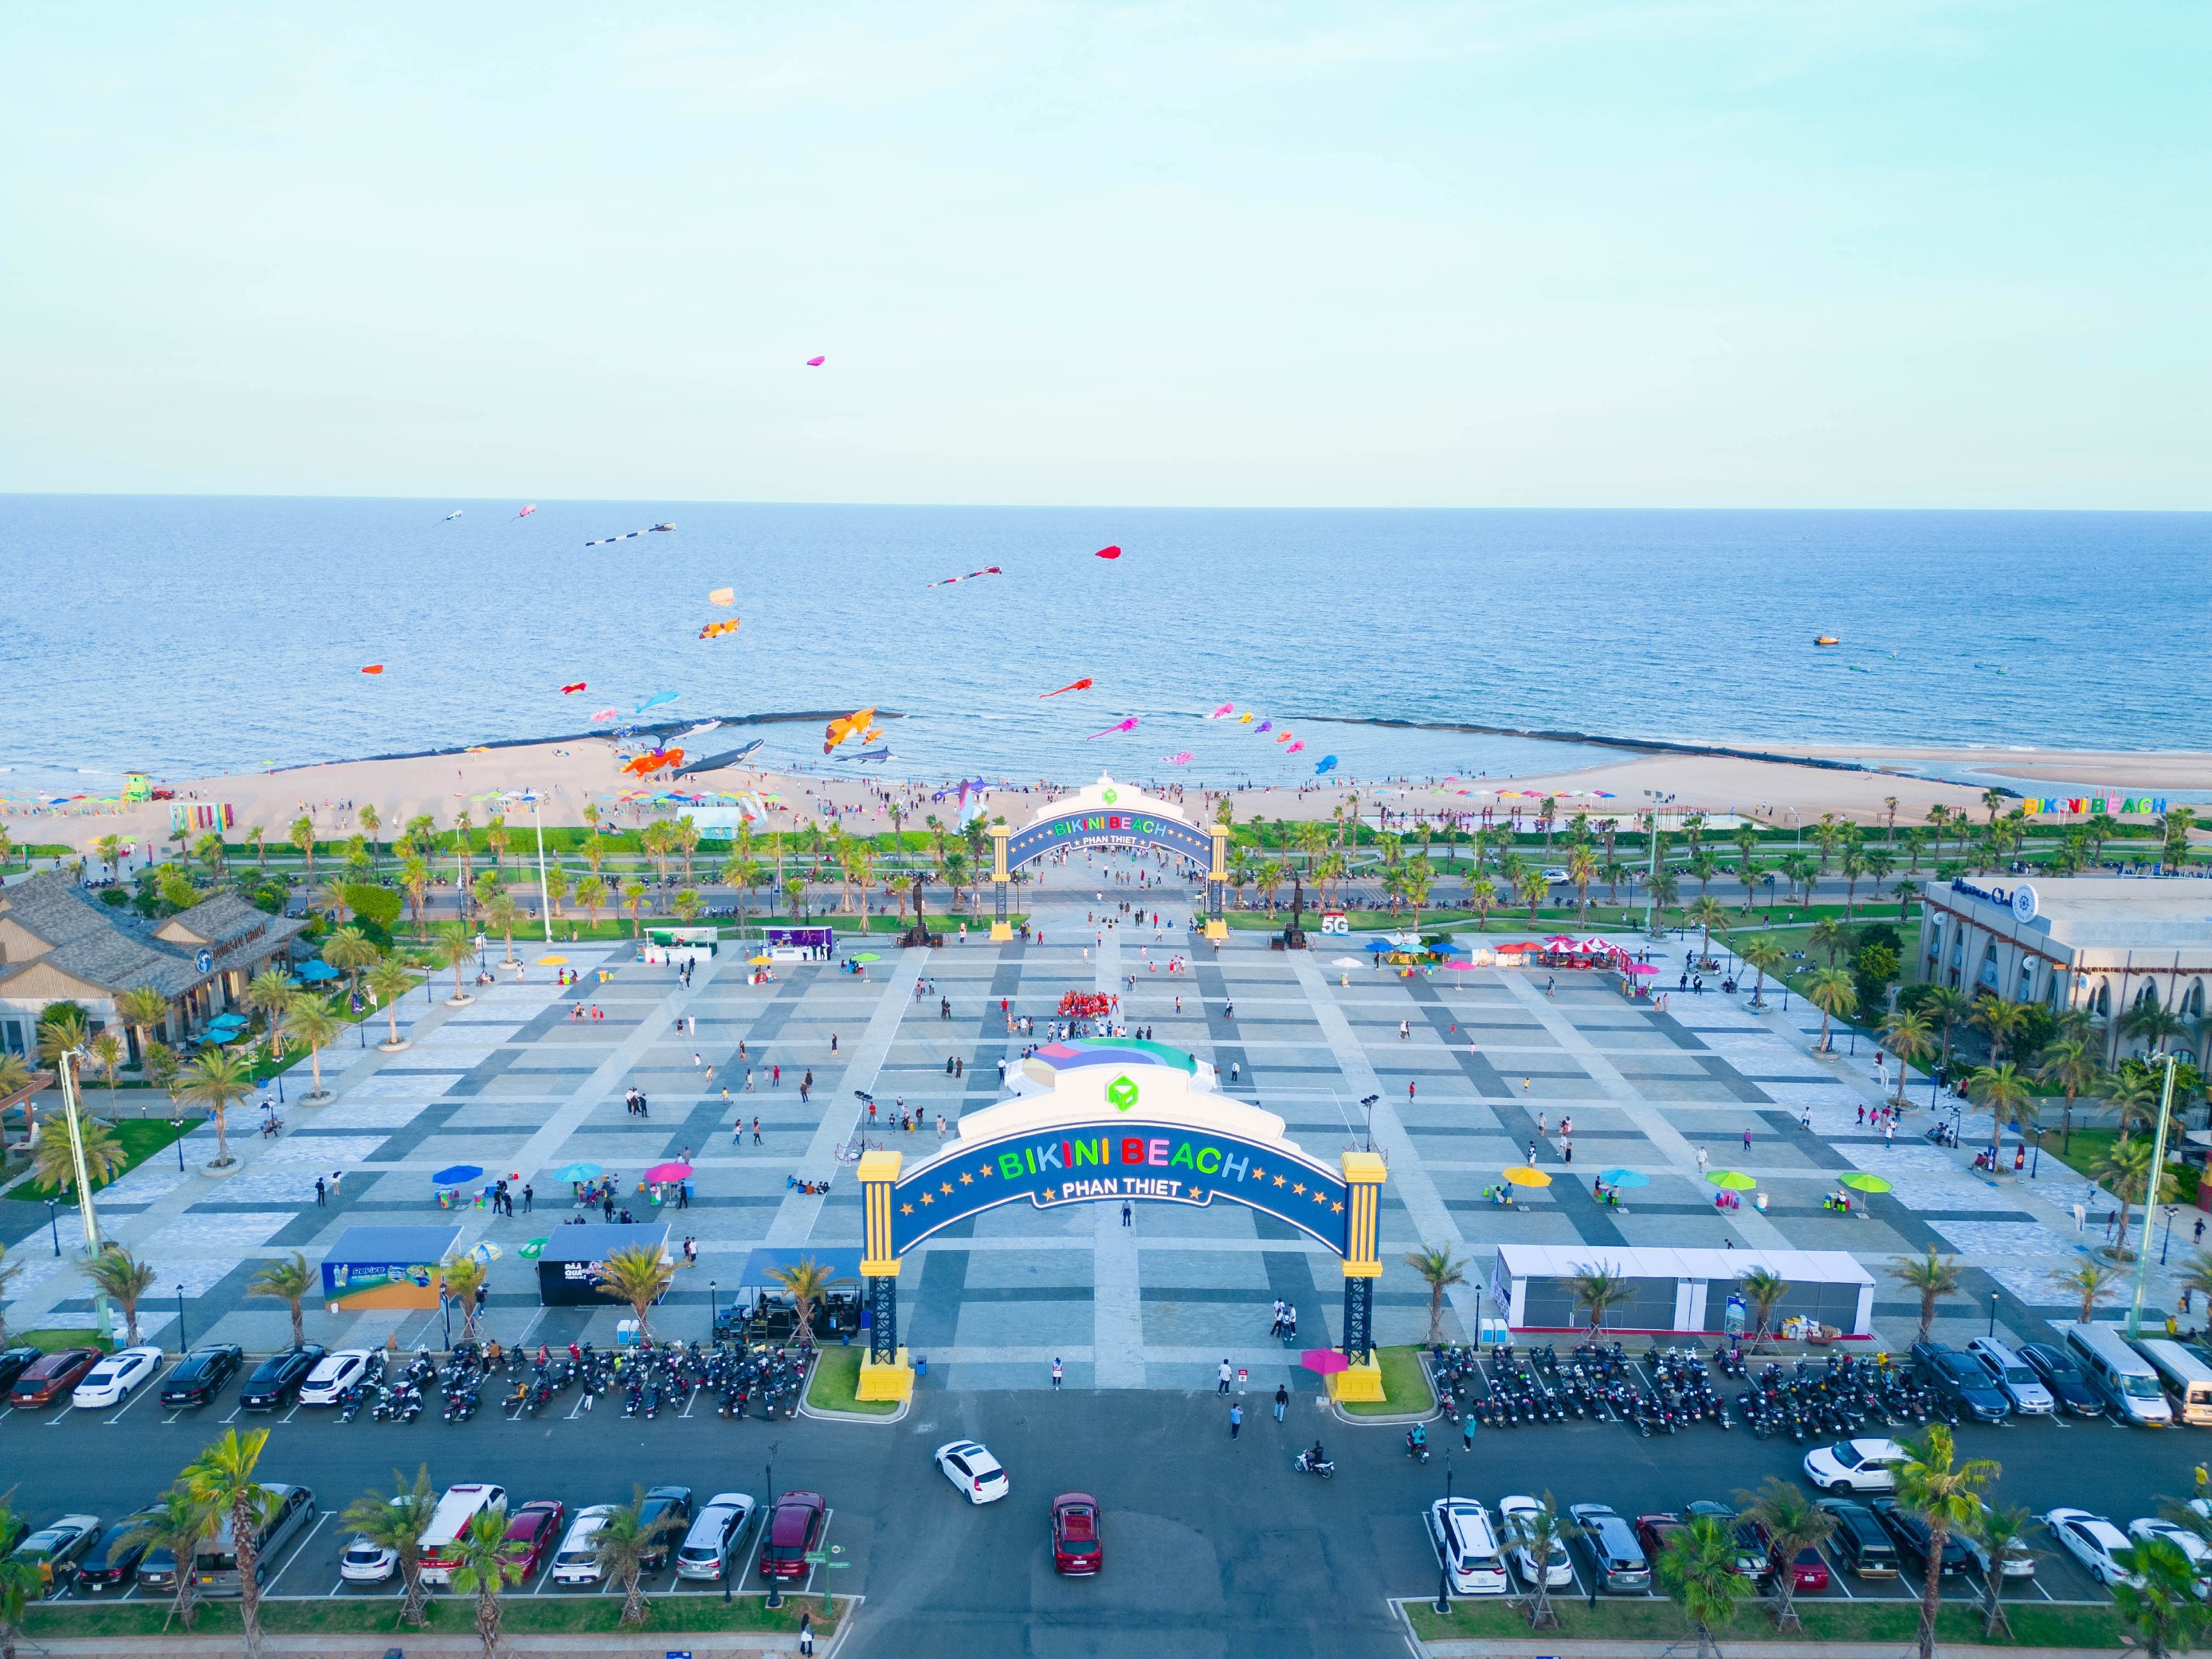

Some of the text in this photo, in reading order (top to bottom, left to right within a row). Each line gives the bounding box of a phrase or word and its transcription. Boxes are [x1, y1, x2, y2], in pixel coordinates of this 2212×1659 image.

[2024, 798, 2087, 814] BIKNI
[2092, 798, 2167, 814] BEACH
[1053, 816, 1167, 837] BIKINI BEACH
[1083, 836, 1137, 845] PHAN THIET
[1321, 916, 1349, 934] 5G
[998, 1137, 1249, 1182] BIKINI BEACH
[1062, 1178, 1182, 1199] PHAN THIET
